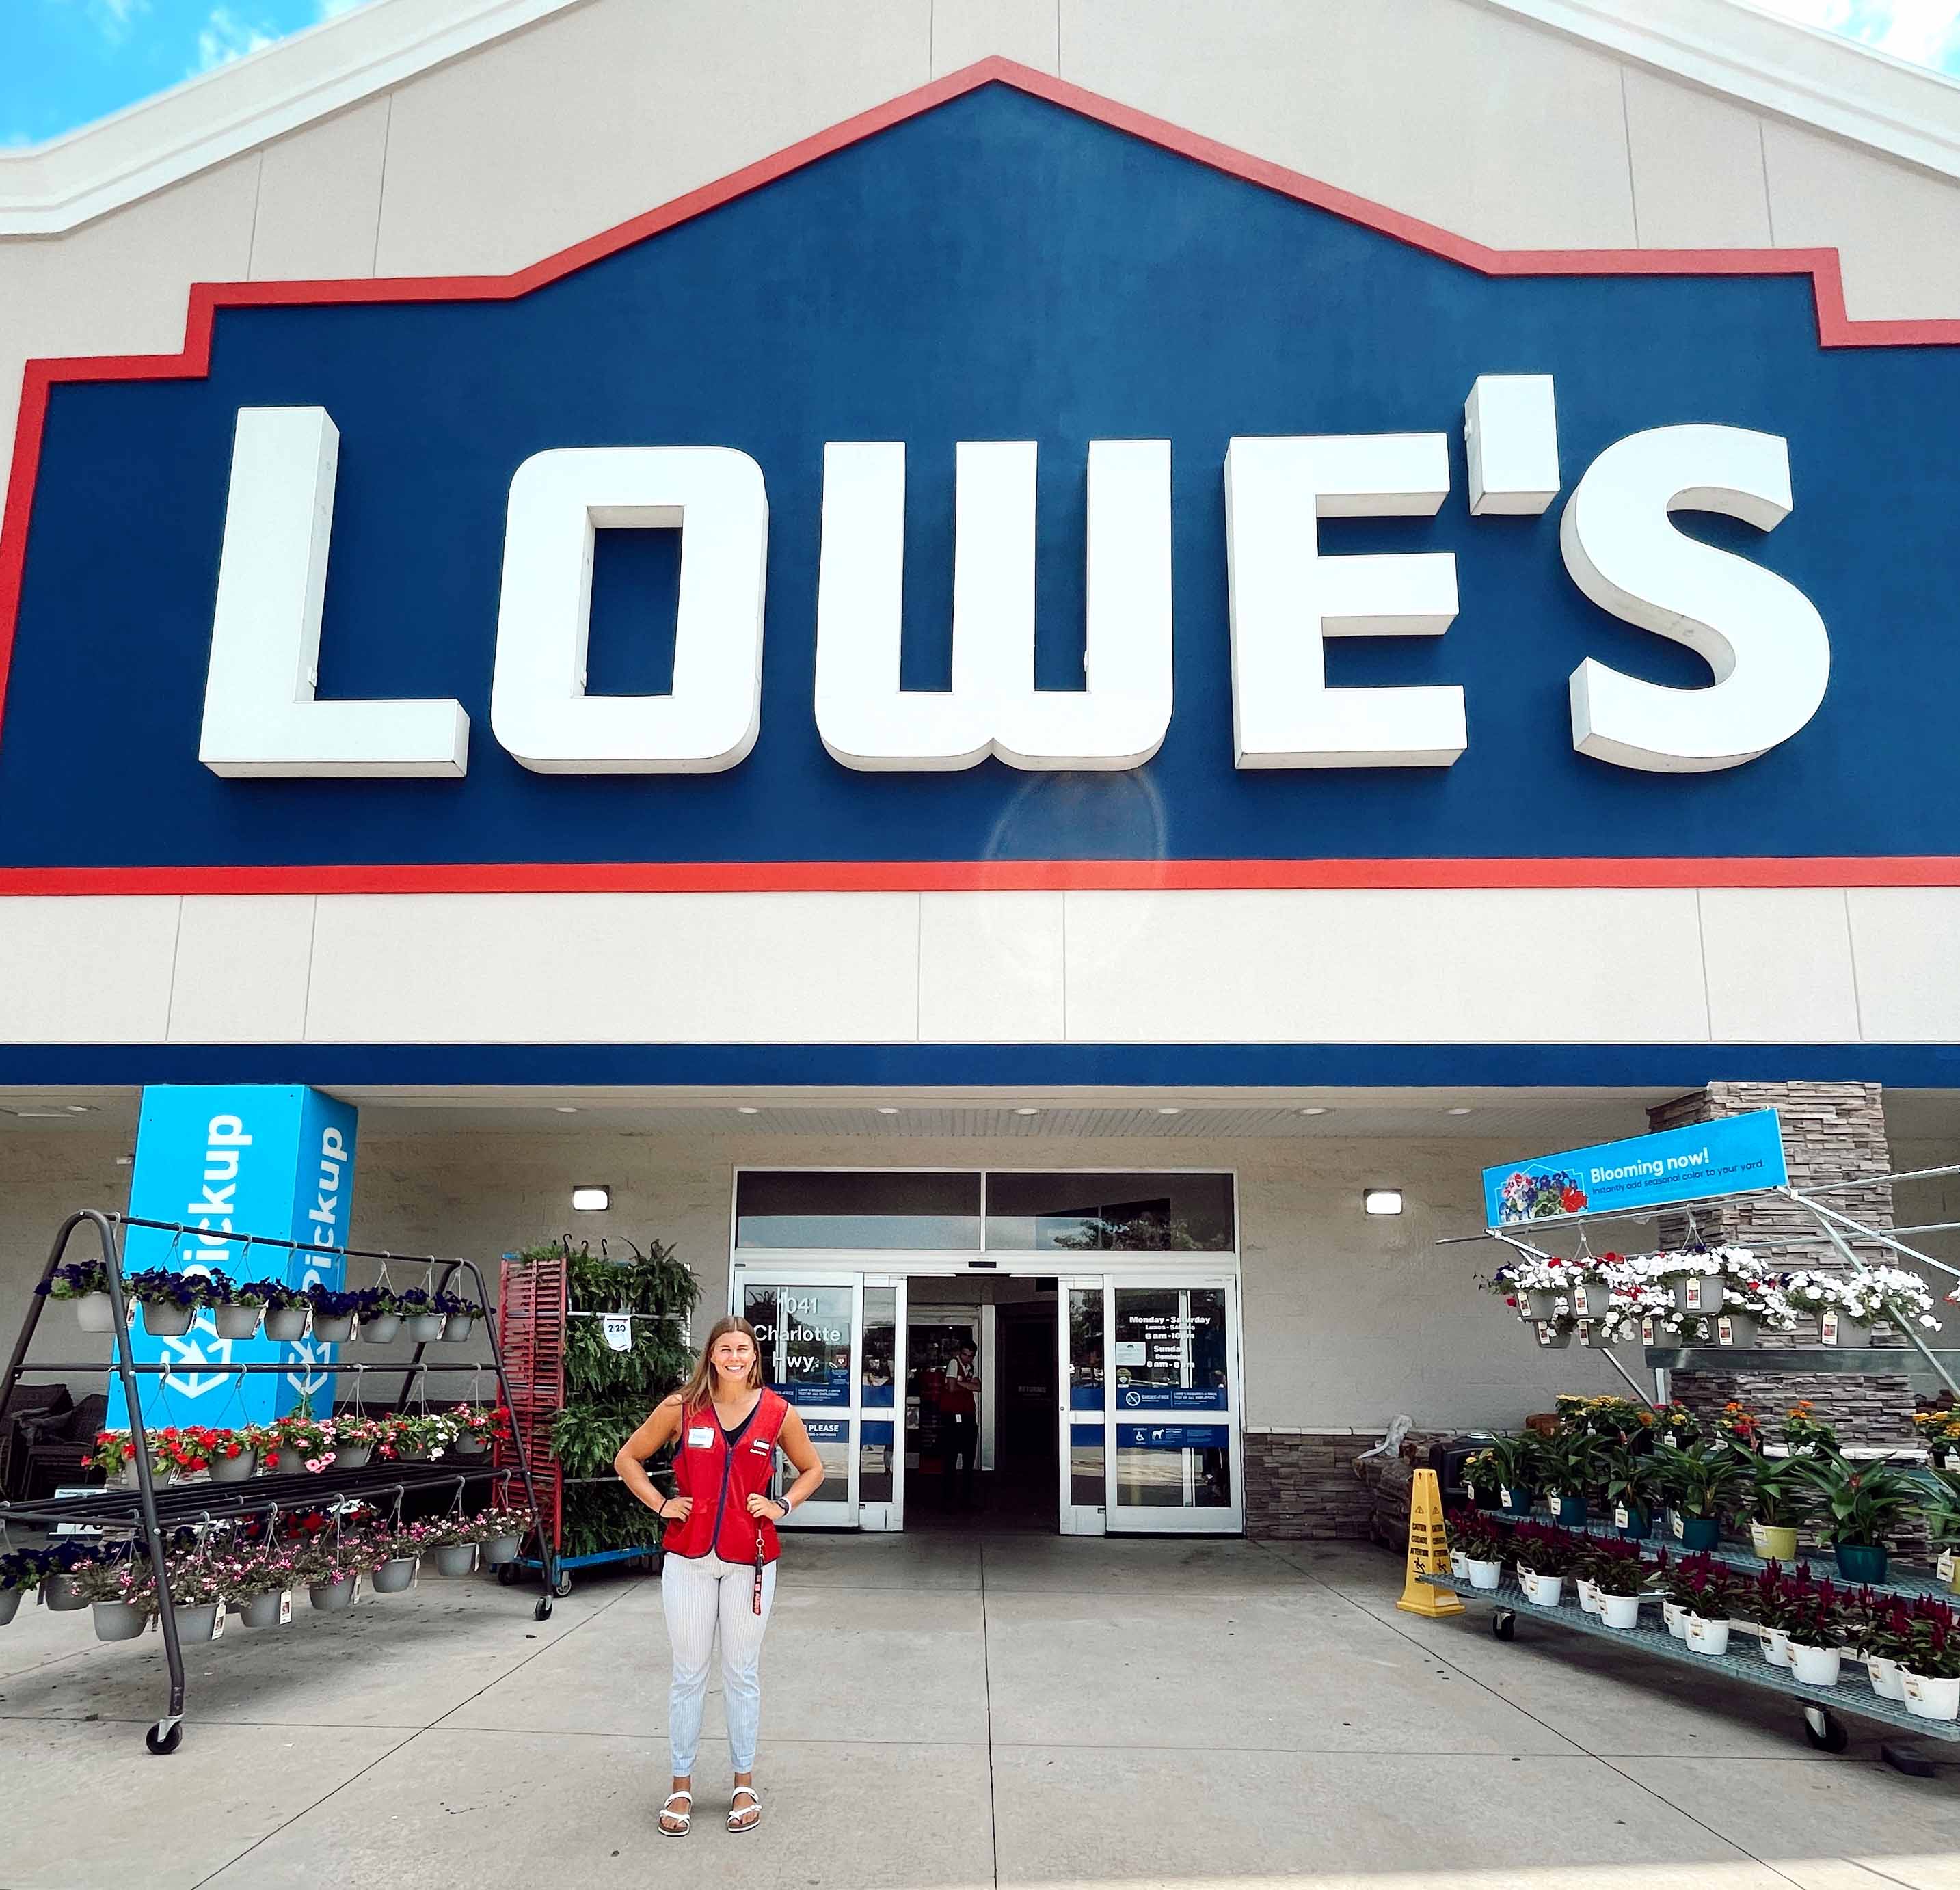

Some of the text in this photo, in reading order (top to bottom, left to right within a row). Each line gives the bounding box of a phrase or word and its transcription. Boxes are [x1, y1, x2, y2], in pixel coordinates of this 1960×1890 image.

[199, 373, 1831, 778] LOWE'S
[1590, 1148, 1710, 1183] Blooming now!
[1592, 1183, 1625, 1196] Instantly
[1627, 1180, 1642, 1189] add
[1644, 1175, 1680, 1187] seasonal
[1682, 1170, 1704, 1182] color
[1706, 1168, 1715, 1177] to
[1717, 1165, 1738, 1177] your
[180, 1114, 252, 1284] ickup
[753, 1325, 841, 1342] Charlotte
[1129, 1316, 1165, 1325] Monday
[773, 1351, 820, 1373] Hwy.
[808, 1424, 840, 1433] PLEASE
